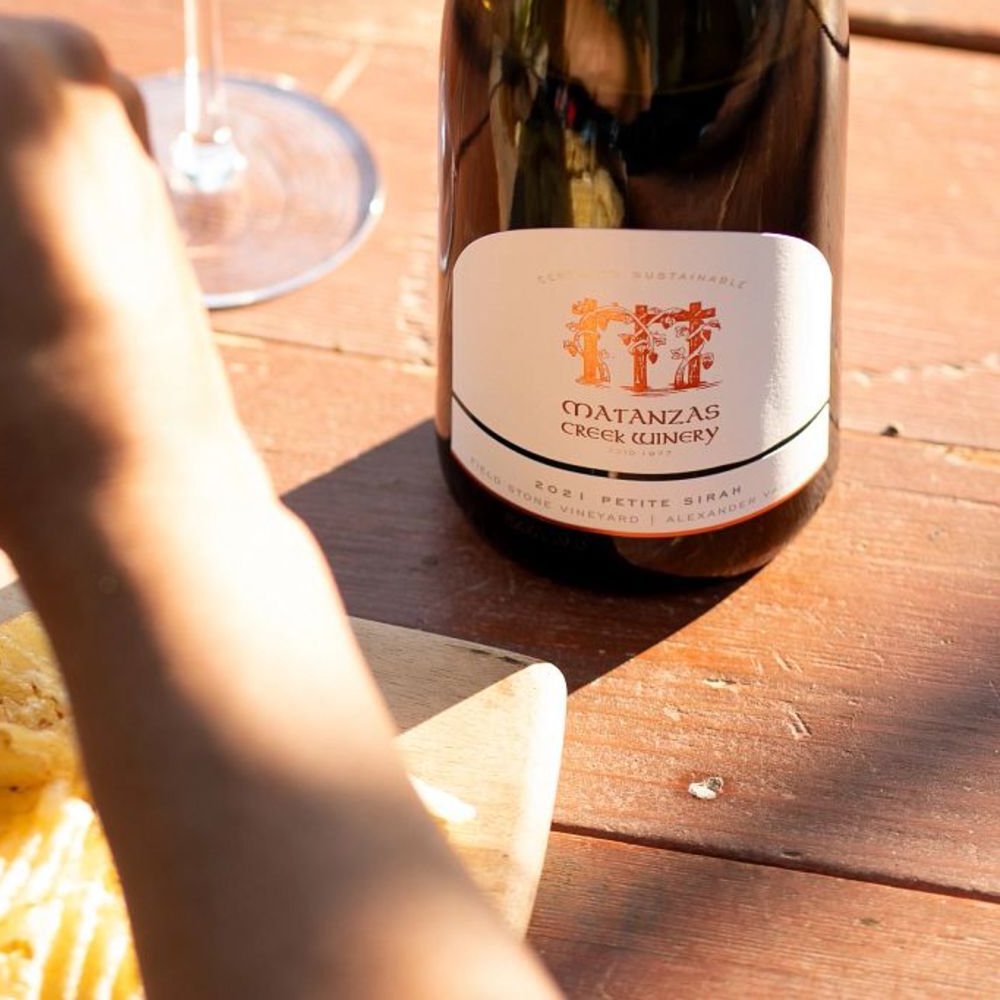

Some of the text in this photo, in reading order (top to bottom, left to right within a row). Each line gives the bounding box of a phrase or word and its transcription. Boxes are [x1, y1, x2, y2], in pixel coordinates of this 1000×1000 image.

[561, 399, 721, 425] MATANZAS
[560, 421, 720, 446] CREEK WINERY
[508, 485, 552, 508] STONE
[559, 505, 640, 524] VINEYARD
[665, 496, 756, 524] ALEXANDER
[534, 480, 584, 501] 2021
[601, 495, 671, 508] PETITE
[683, 485, 742, 506] SIRAH
